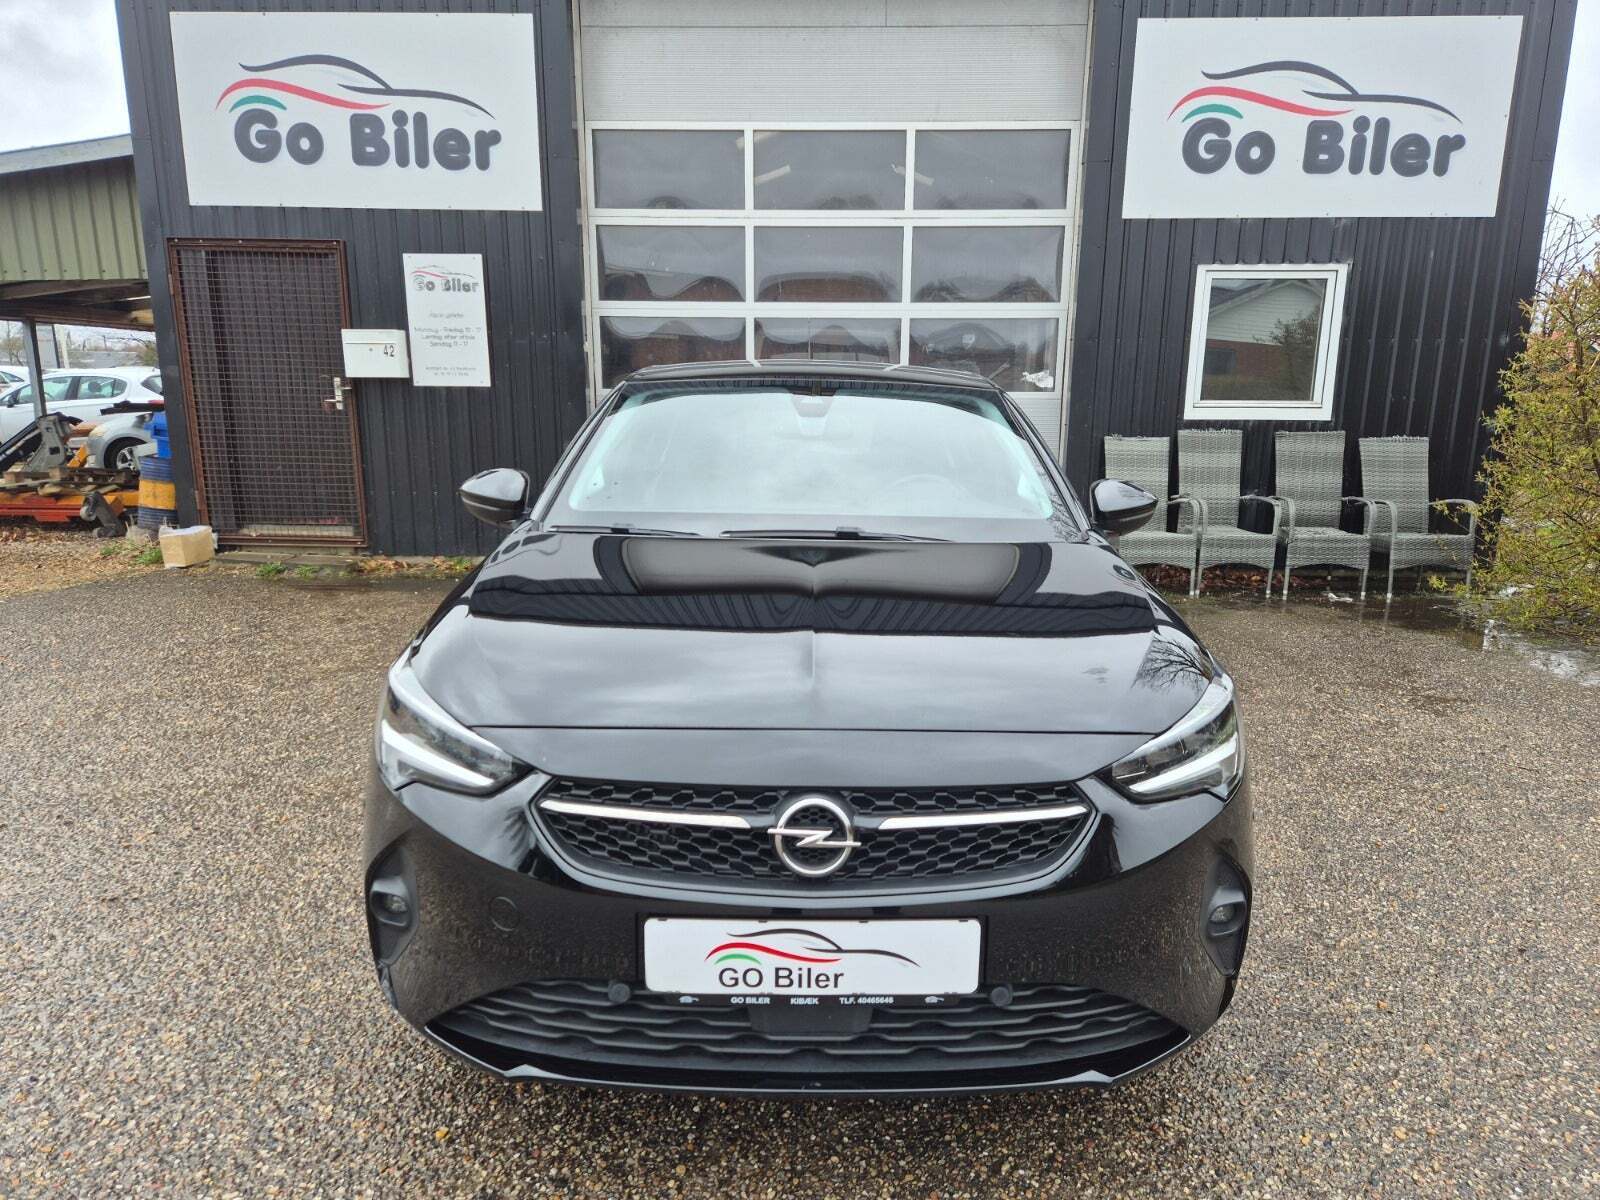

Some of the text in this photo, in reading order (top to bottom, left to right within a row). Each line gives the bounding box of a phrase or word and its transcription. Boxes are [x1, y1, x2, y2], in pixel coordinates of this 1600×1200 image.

[234, 108, 502, 171] Go Biler
[1182, 115, 1467, 177] Go Biler
[384, 345, 395, 358] 42
[719, 967, 844, 988] GO Biler
[730, 996, 771, 1005] GO BILER
